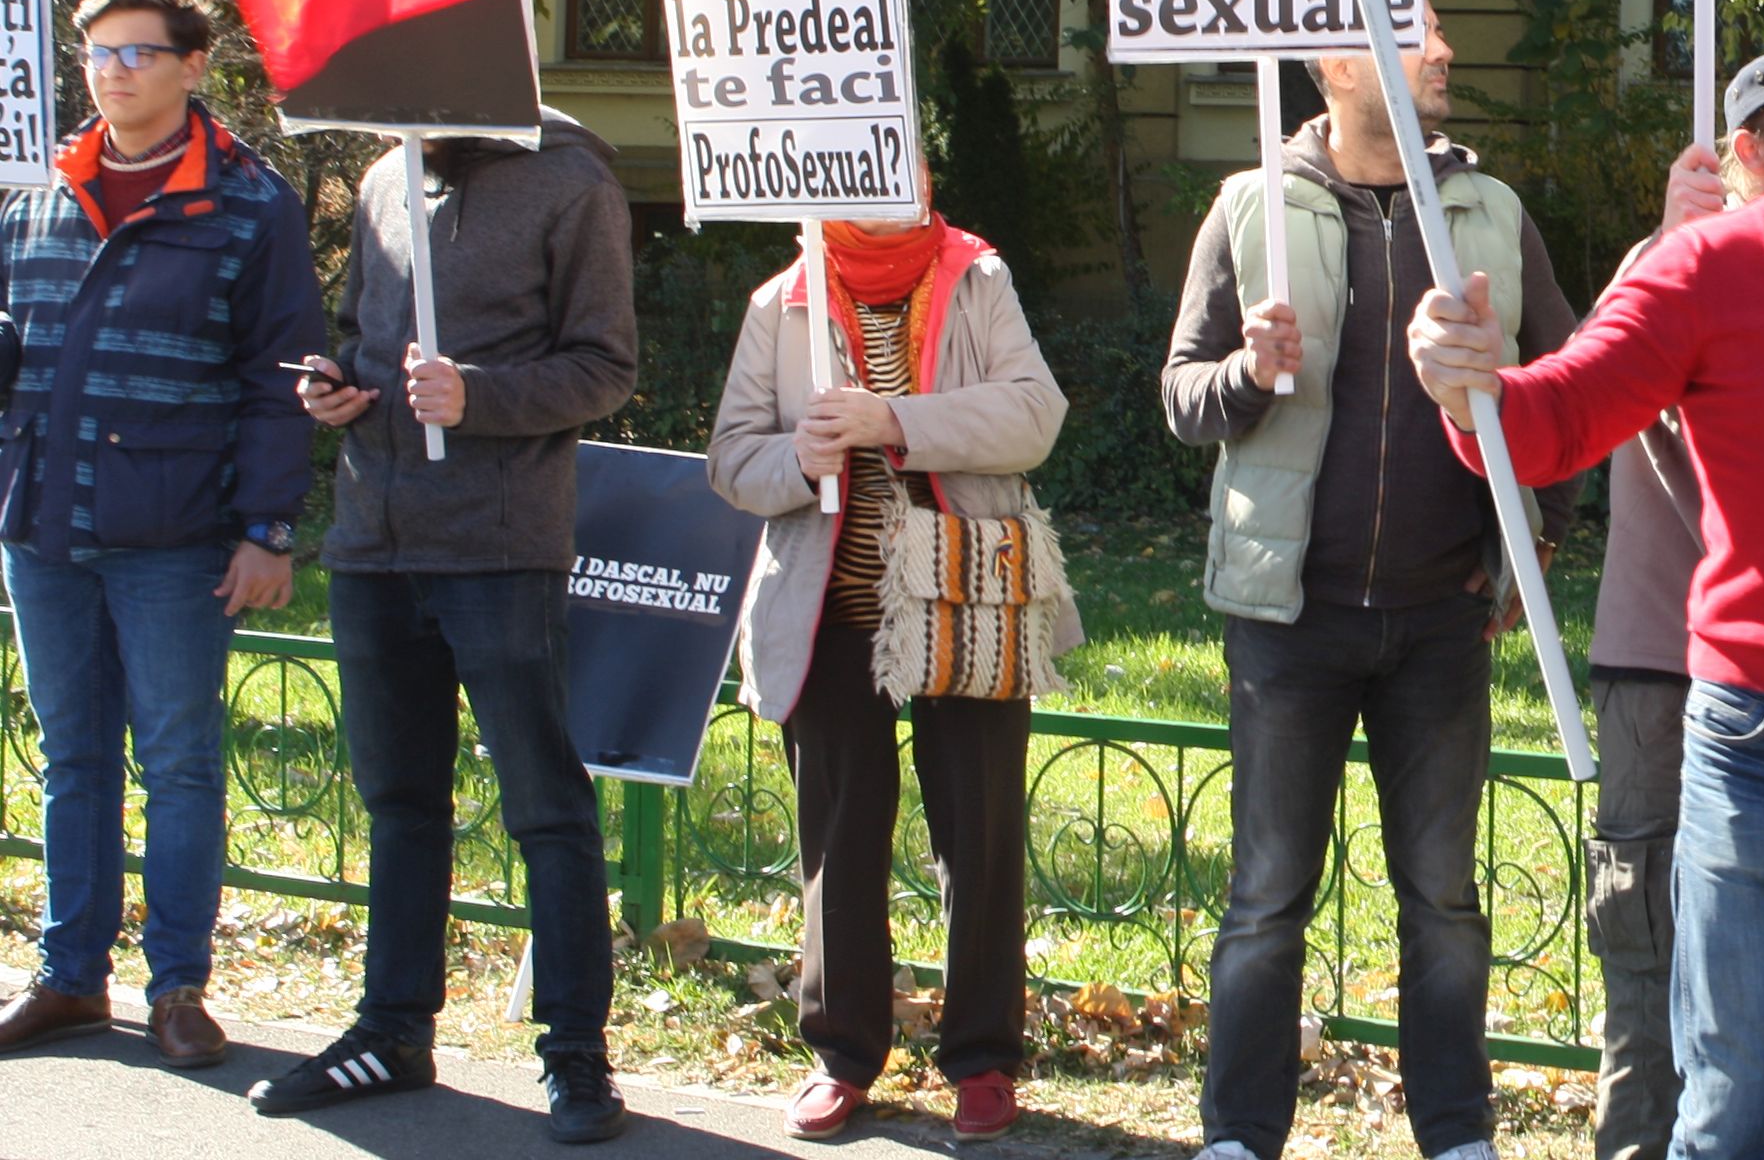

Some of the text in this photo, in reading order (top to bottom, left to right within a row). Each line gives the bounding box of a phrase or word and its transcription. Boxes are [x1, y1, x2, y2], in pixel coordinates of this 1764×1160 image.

[680, 54, 901, 109] te faci
[693, 124, 902, 200] ProfoSexual?
[568, 575, 721, 614] OFOSEXUAL
[585, 557, 690, 592] DASCAL,
[693, 572, 732, 594] NU
